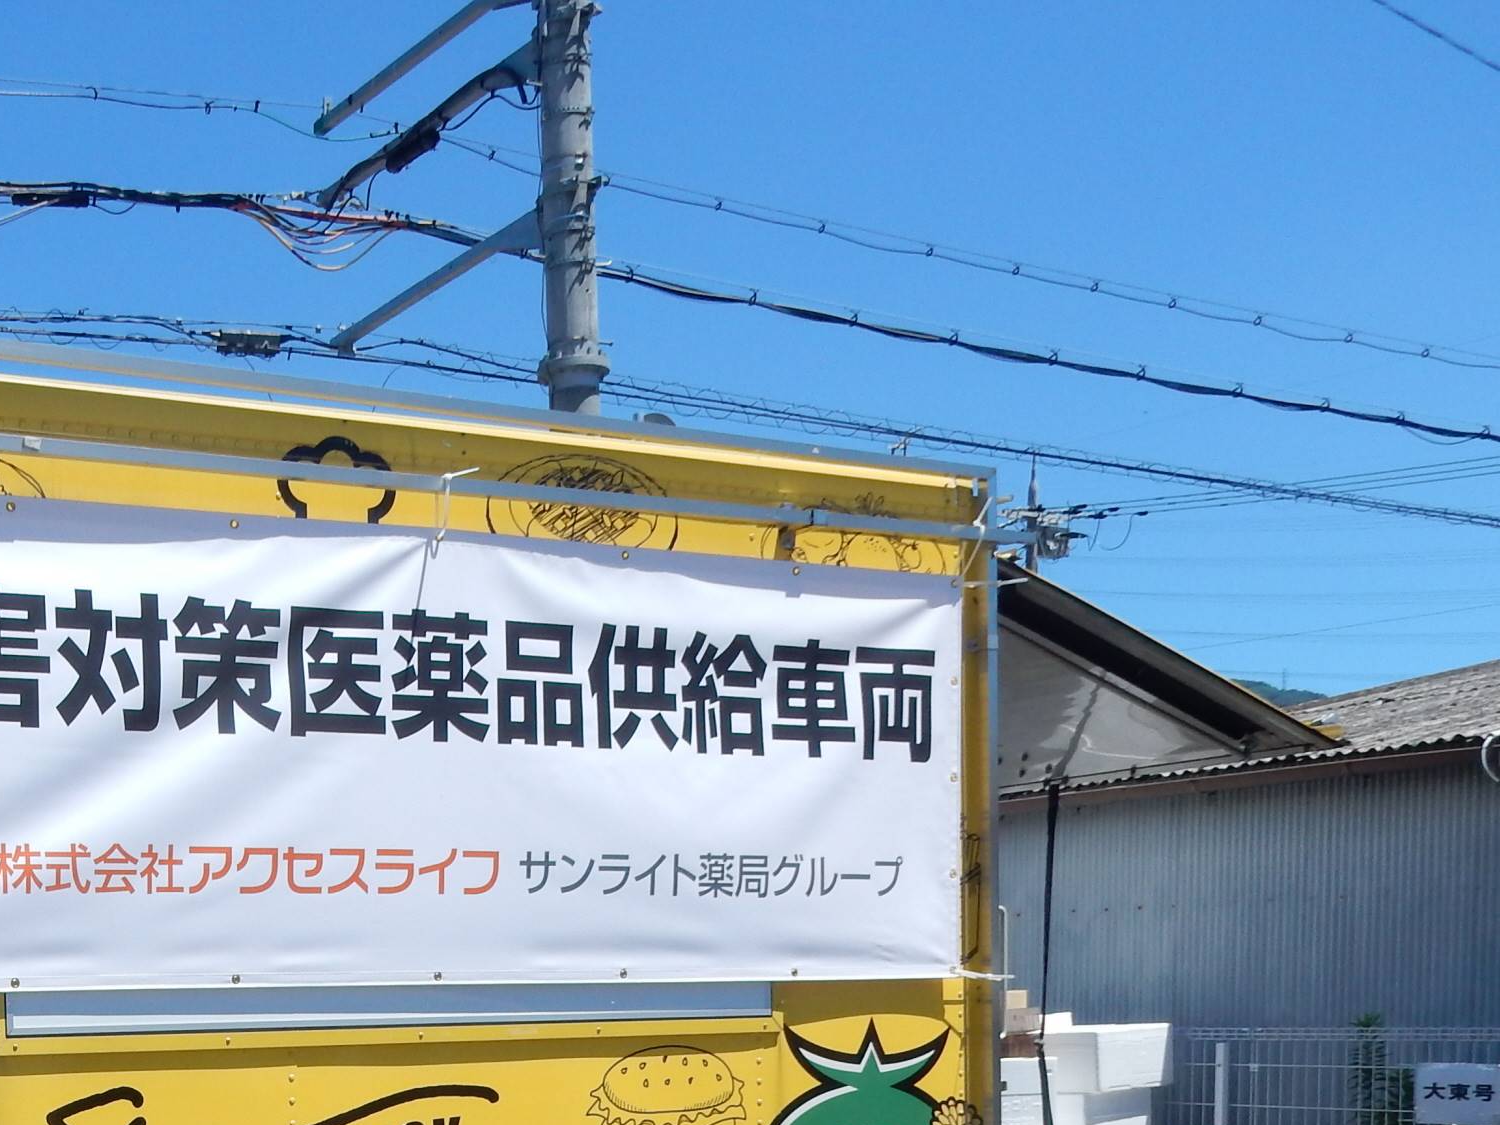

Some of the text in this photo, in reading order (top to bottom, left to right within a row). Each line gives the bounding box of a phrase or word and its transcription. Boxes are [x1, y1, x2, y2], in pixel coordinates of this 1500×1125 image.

[519, 849, 904, 899] サンライト薬局グループ
